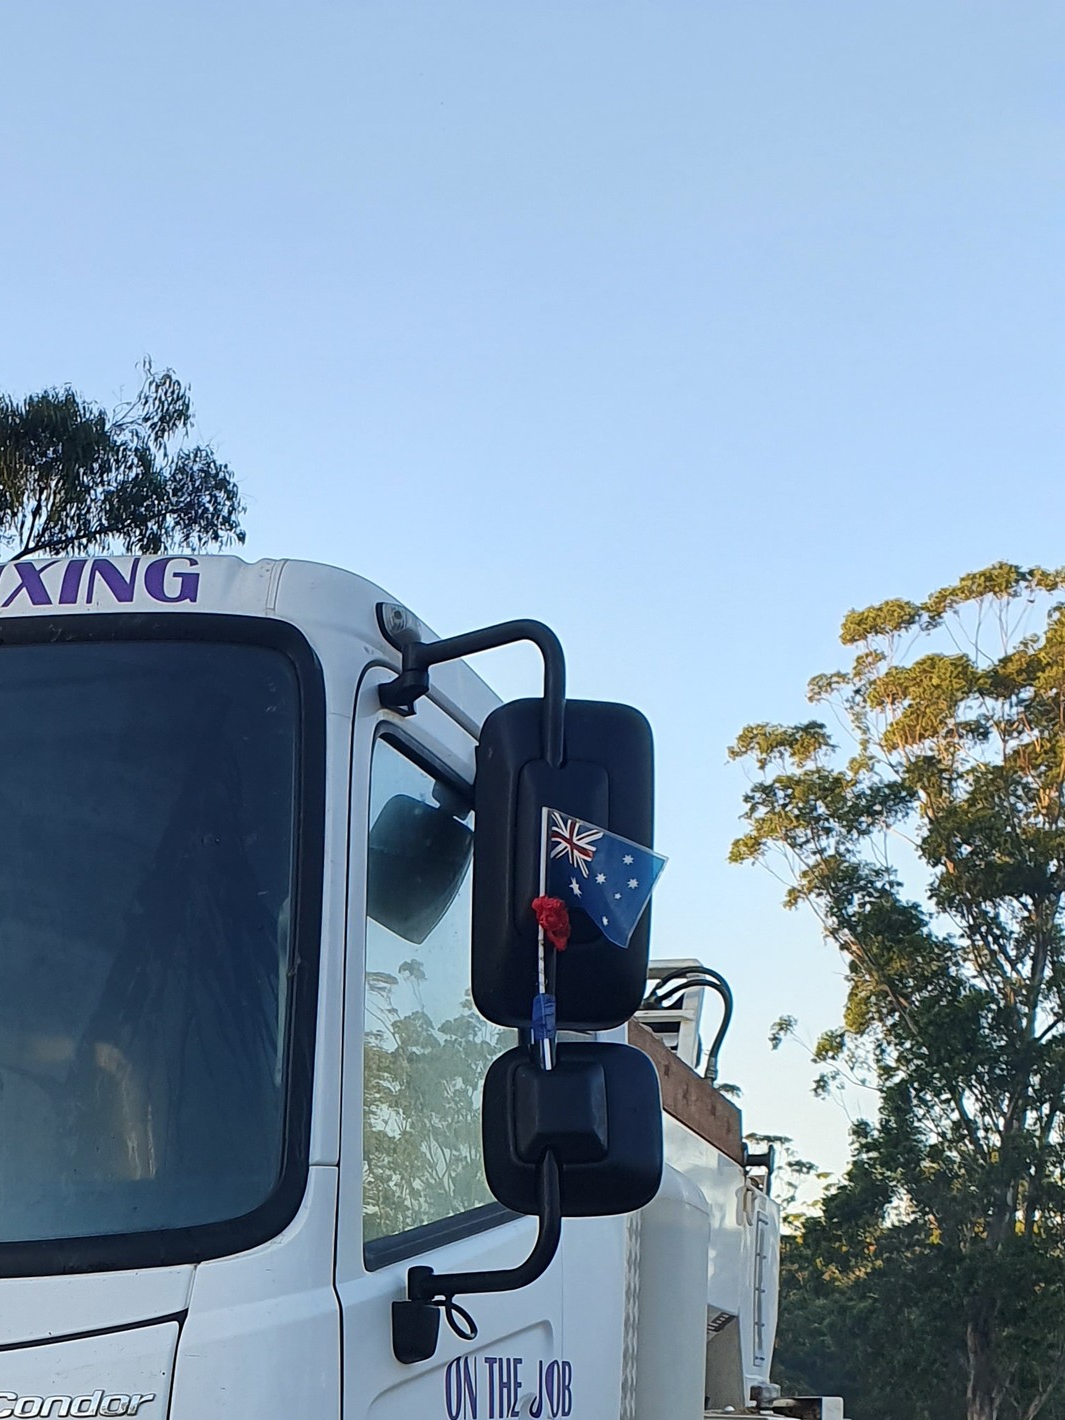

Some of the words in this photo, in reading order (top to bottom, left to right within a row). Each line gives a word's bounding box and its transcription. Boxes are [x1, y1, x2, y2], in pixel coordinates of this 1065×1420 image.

[444, 1355, 478, 1420] ON
[483, 1356, 524, 1419] THE
[529, 1358, 573, 1419] JOB
